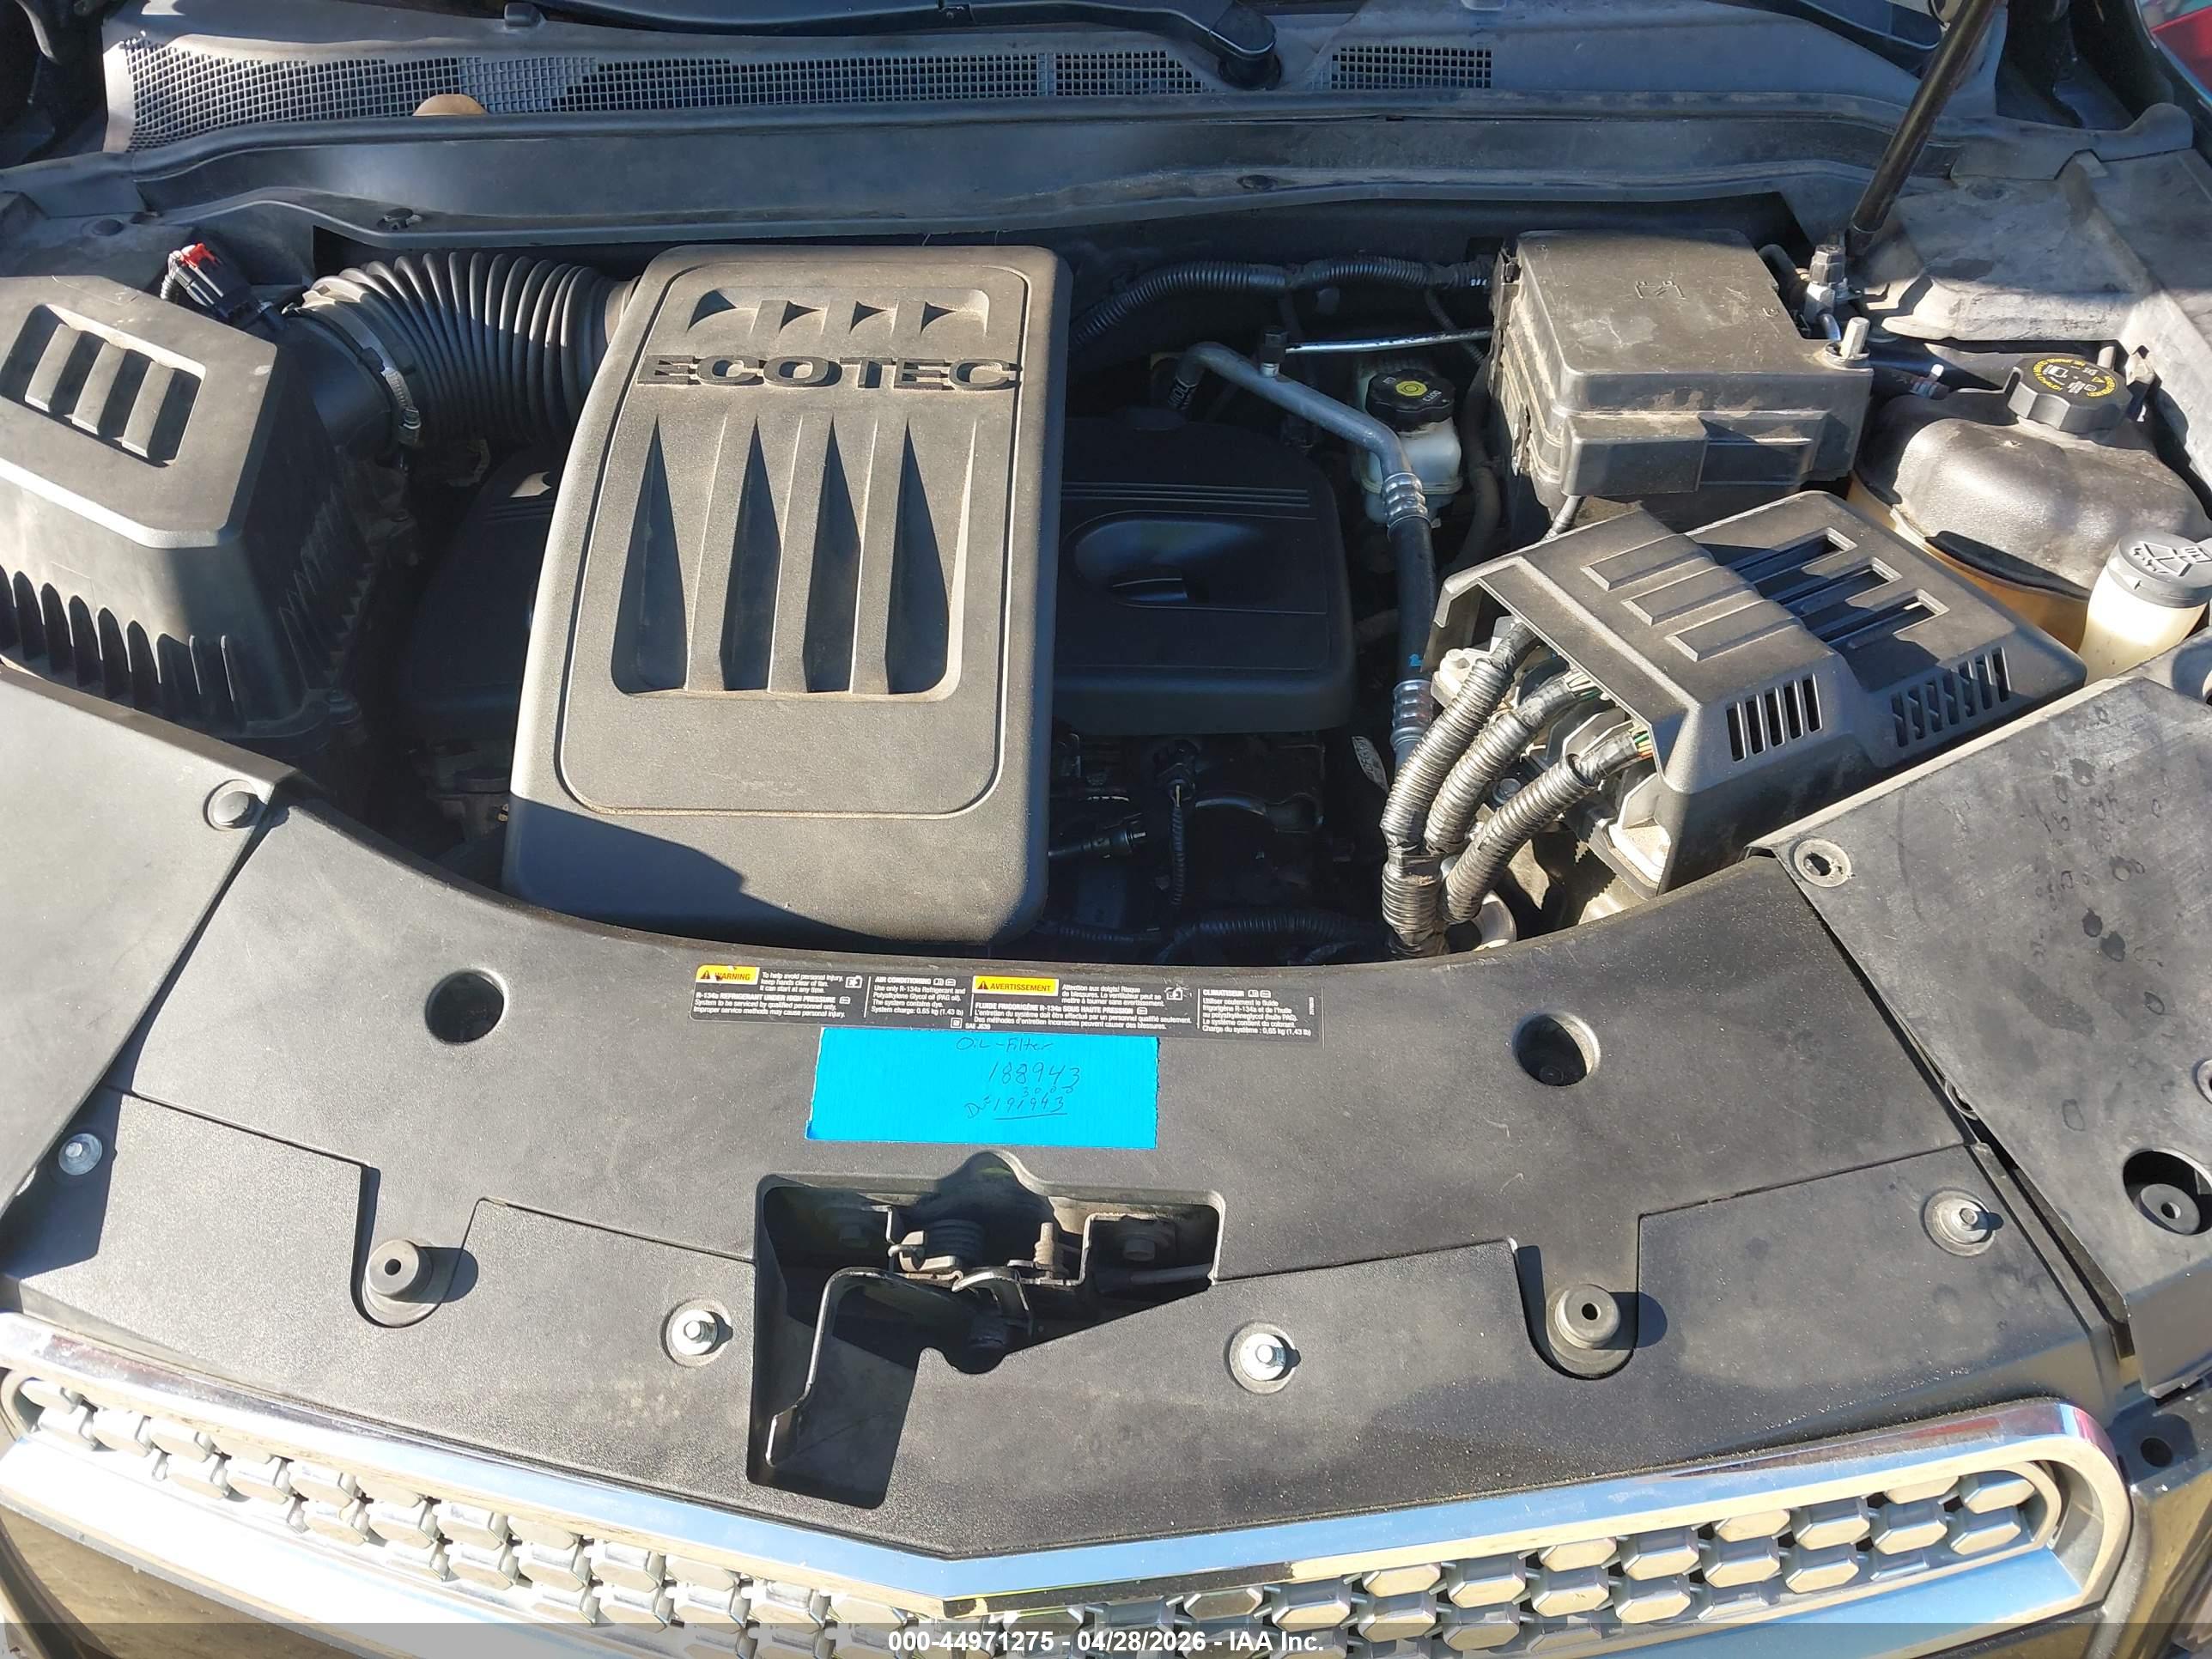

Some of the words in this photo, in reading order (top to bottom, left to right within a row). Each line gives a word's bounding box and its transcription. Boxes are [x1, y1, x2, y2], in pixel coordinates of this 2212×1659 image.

[636, 355, 1020, 391] ECOTEC
[714, 972, 751, 981] WARNING
[990, 983, 1051, 992] AVERTISSEMENT
[989, 1061, 1080, 1087] 188943
